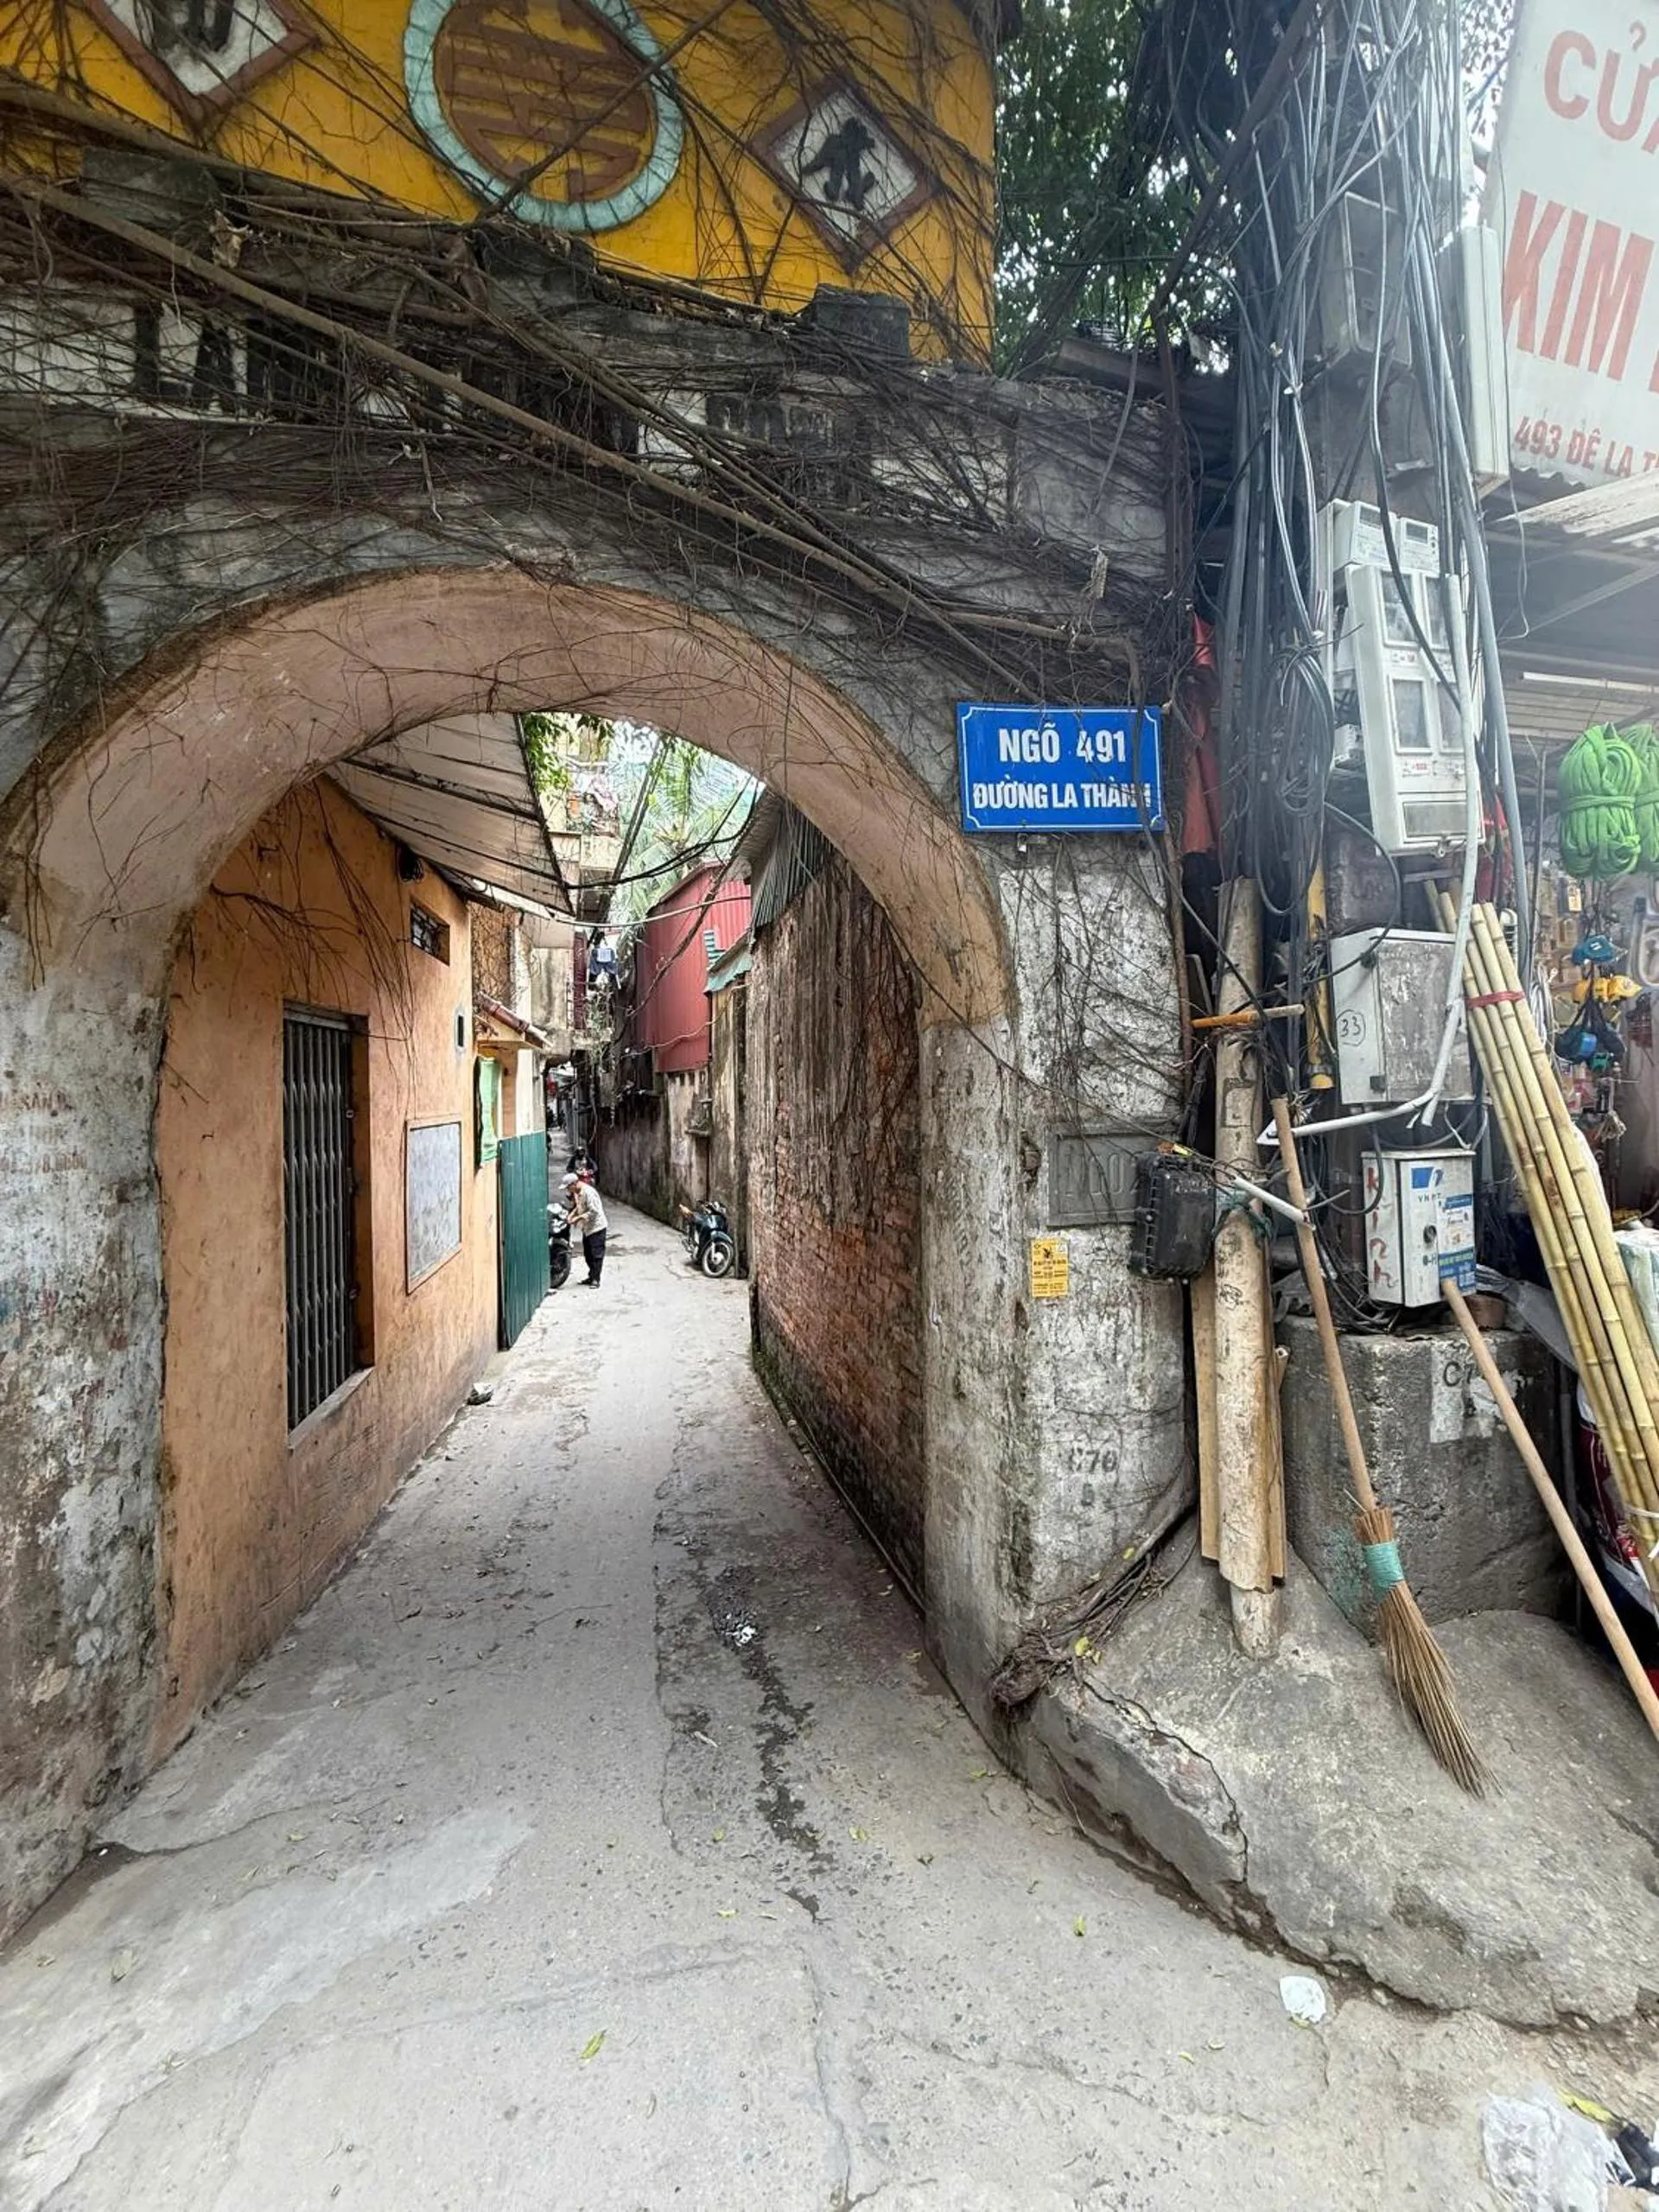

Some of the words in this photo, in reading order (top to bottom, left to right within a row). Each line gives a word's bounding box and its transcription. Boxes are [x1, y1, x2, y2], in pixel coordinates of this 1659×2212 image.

[1502, 188, 1655, 382] KIM
[1514, 416, 1563, 459] 493
[1604, 440, 1634, 478] LA
[1641, 450, 1659, 473] T
[998, 722, 1060, 763] NGÕ
[1076, 729, 1127, 763] 491
[973, 774, 1048, 809] ĐƯỜNG
[1052, 783, 1078, 809] LA
